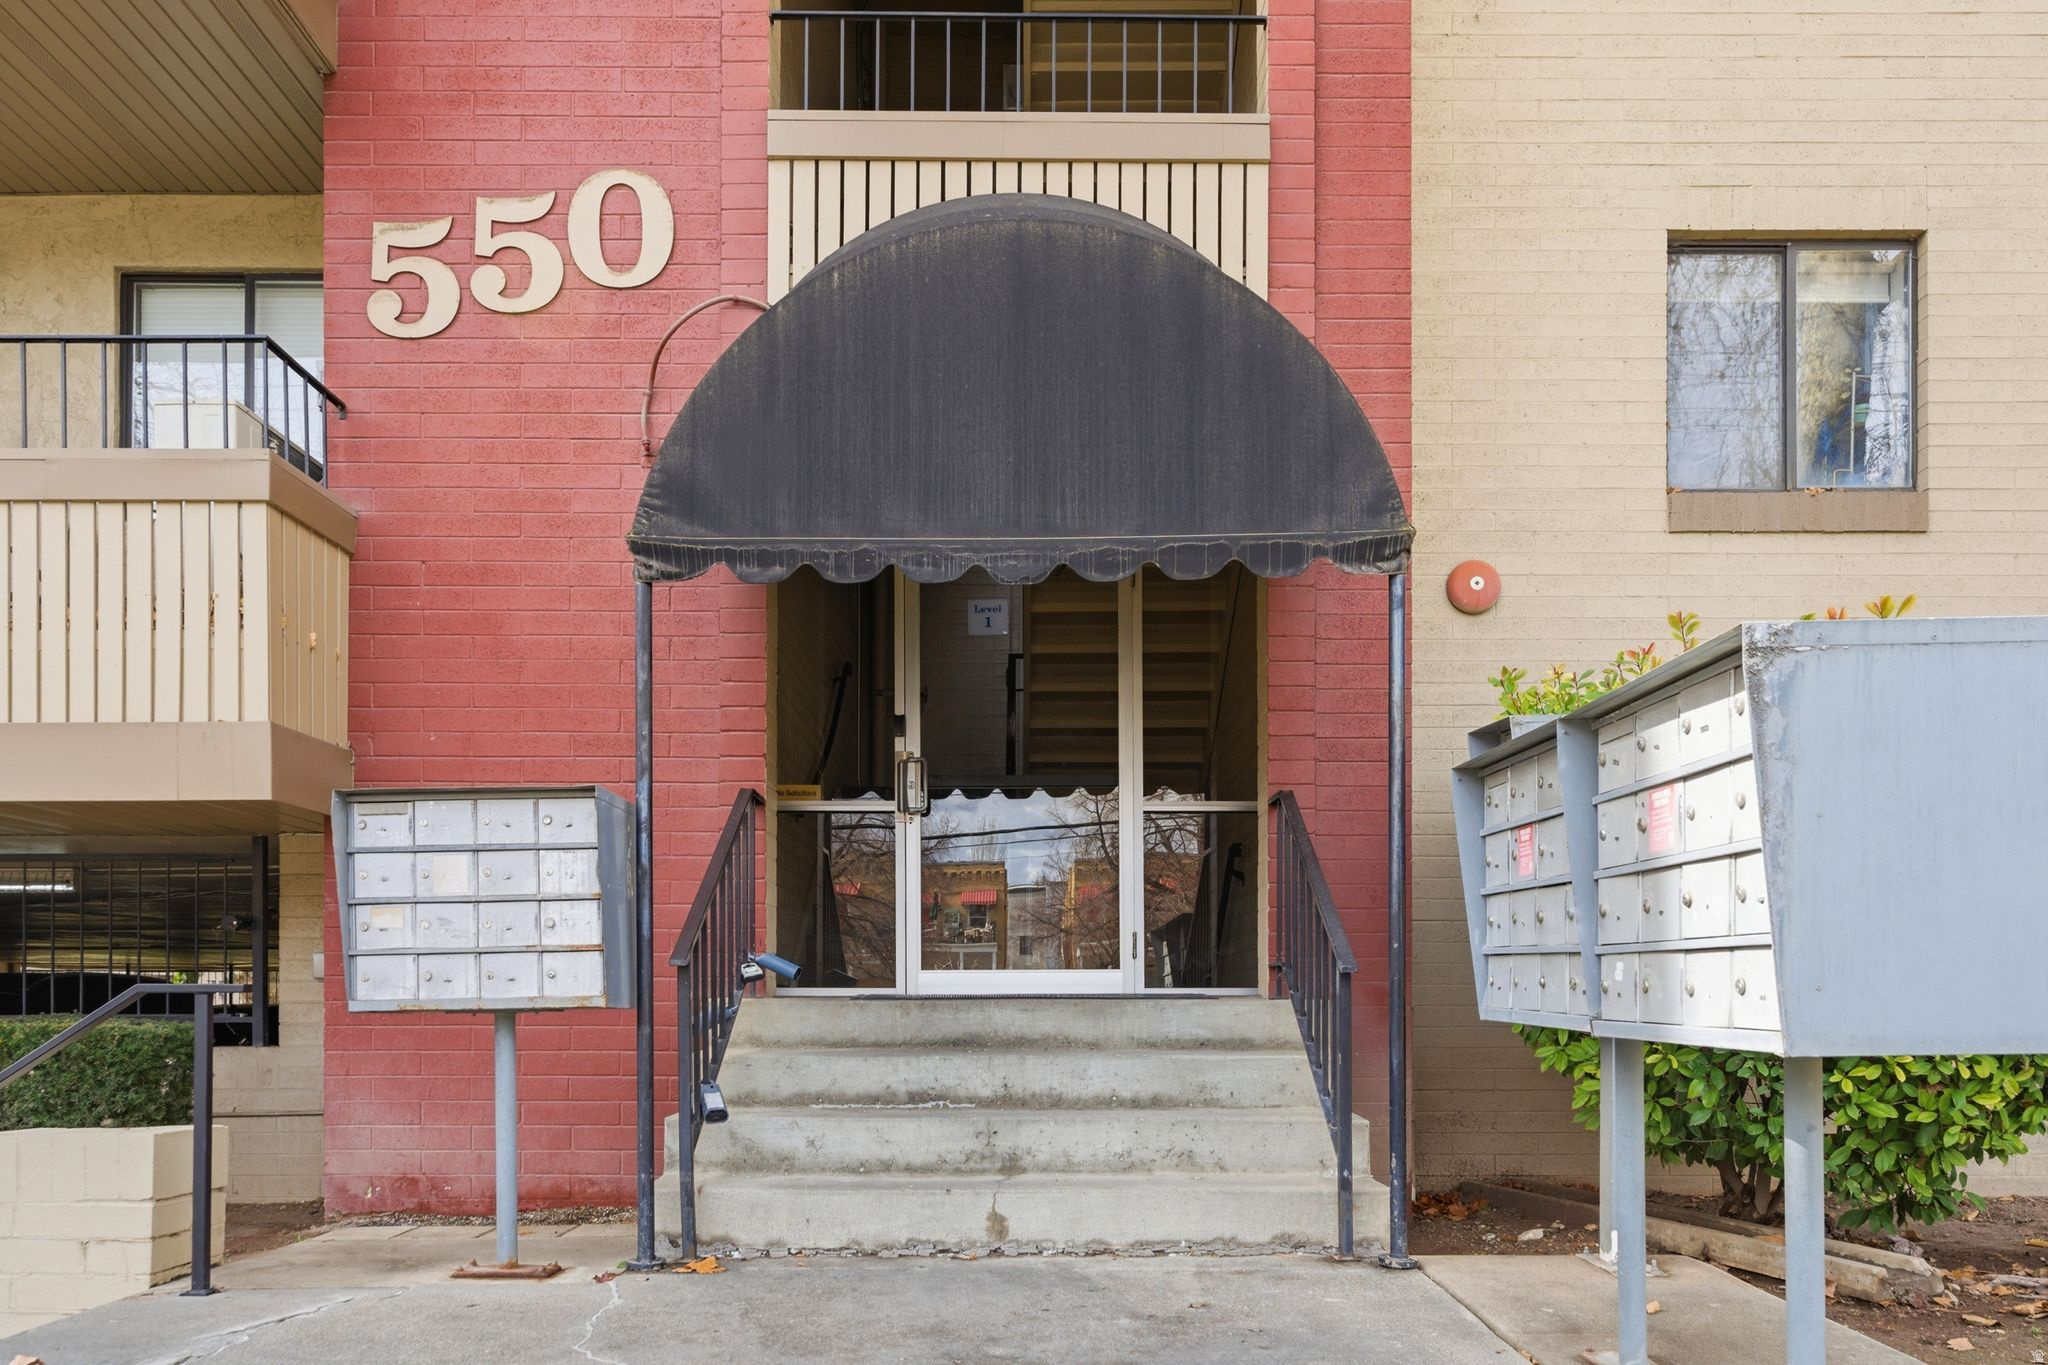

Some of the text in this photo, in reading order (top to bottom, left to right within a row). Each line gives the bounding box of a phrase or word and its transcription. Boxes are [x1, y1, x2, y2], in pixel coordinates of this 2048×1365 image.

[366, 168, 675, 339] 550
[974, 604, 1001, 613] Level
[985, 616, 992, 628] 1
